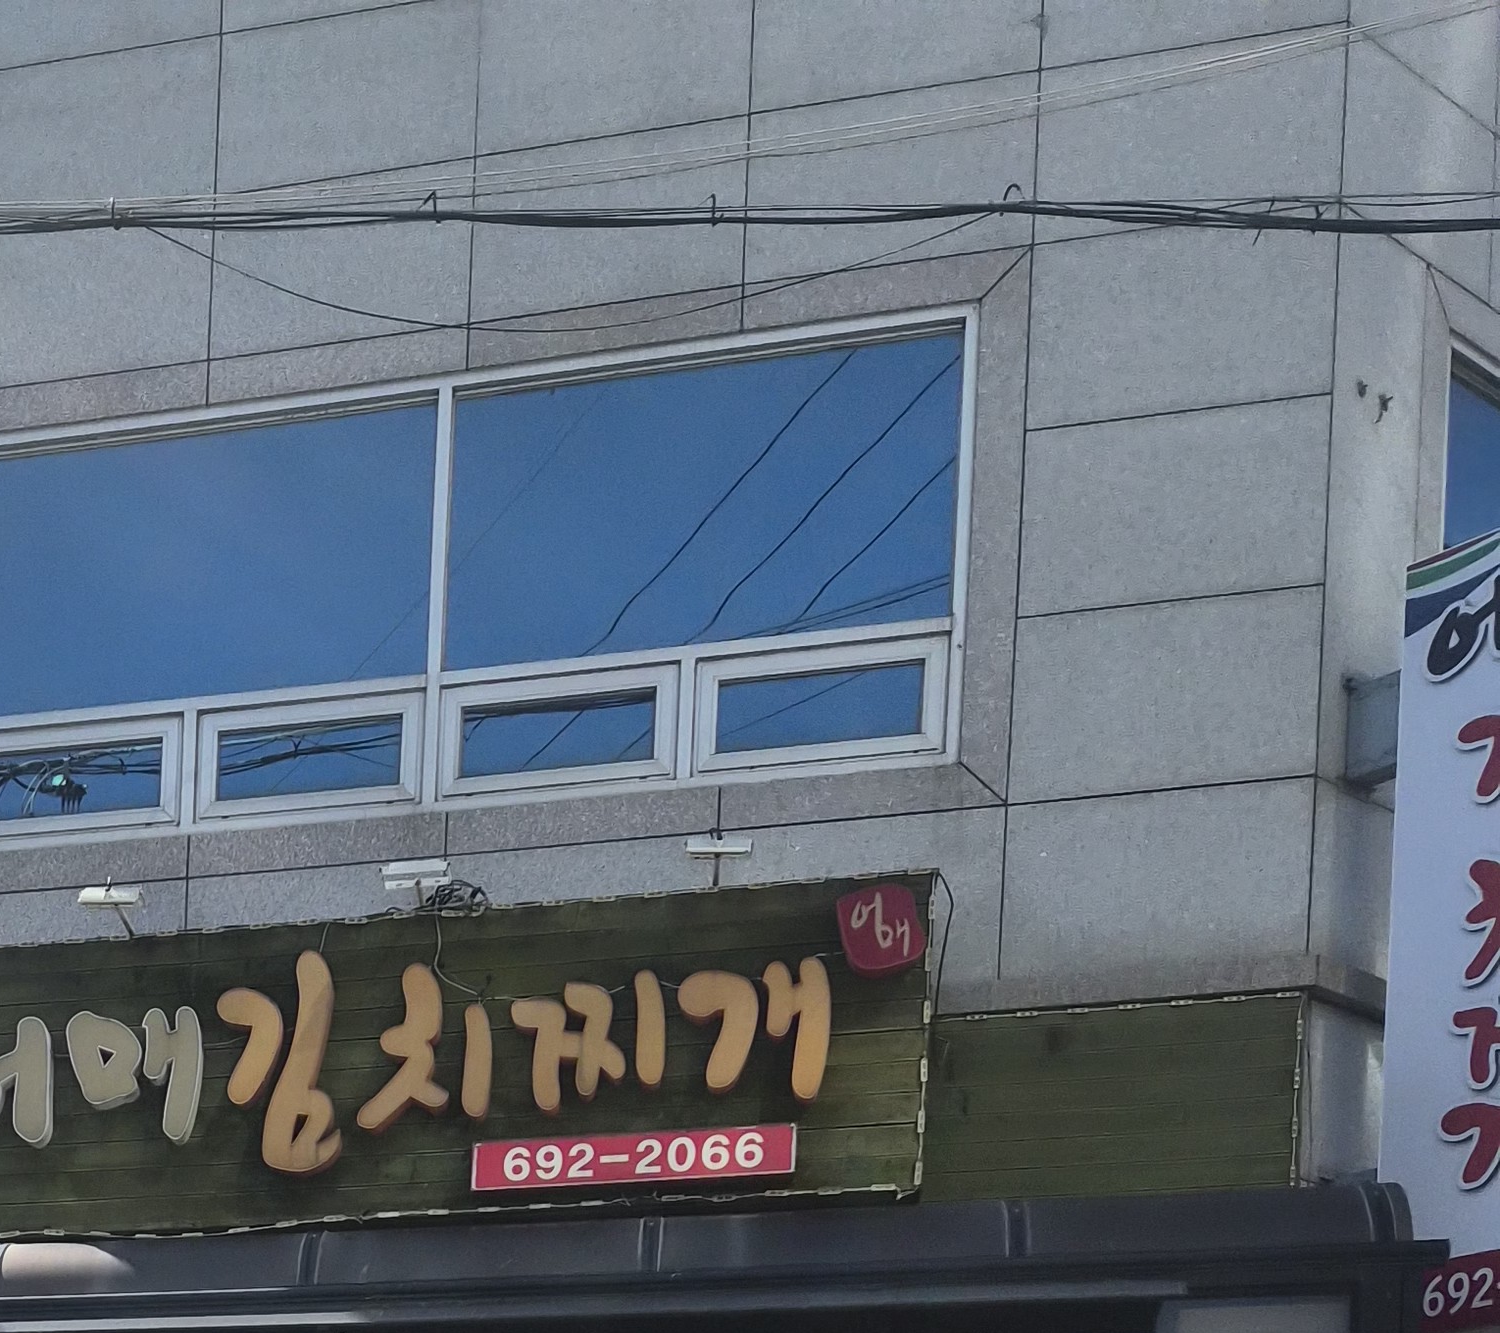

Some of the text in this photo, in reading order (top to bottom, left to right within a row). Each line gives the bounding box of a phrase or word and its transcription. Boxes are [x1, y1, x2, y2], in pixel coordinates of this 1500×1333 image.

[217, 948, 832, 1175] 김치찌개
[502, 1130, 765, 1182] 692-2066
[1422, 1267, 1500, 1317] 692
